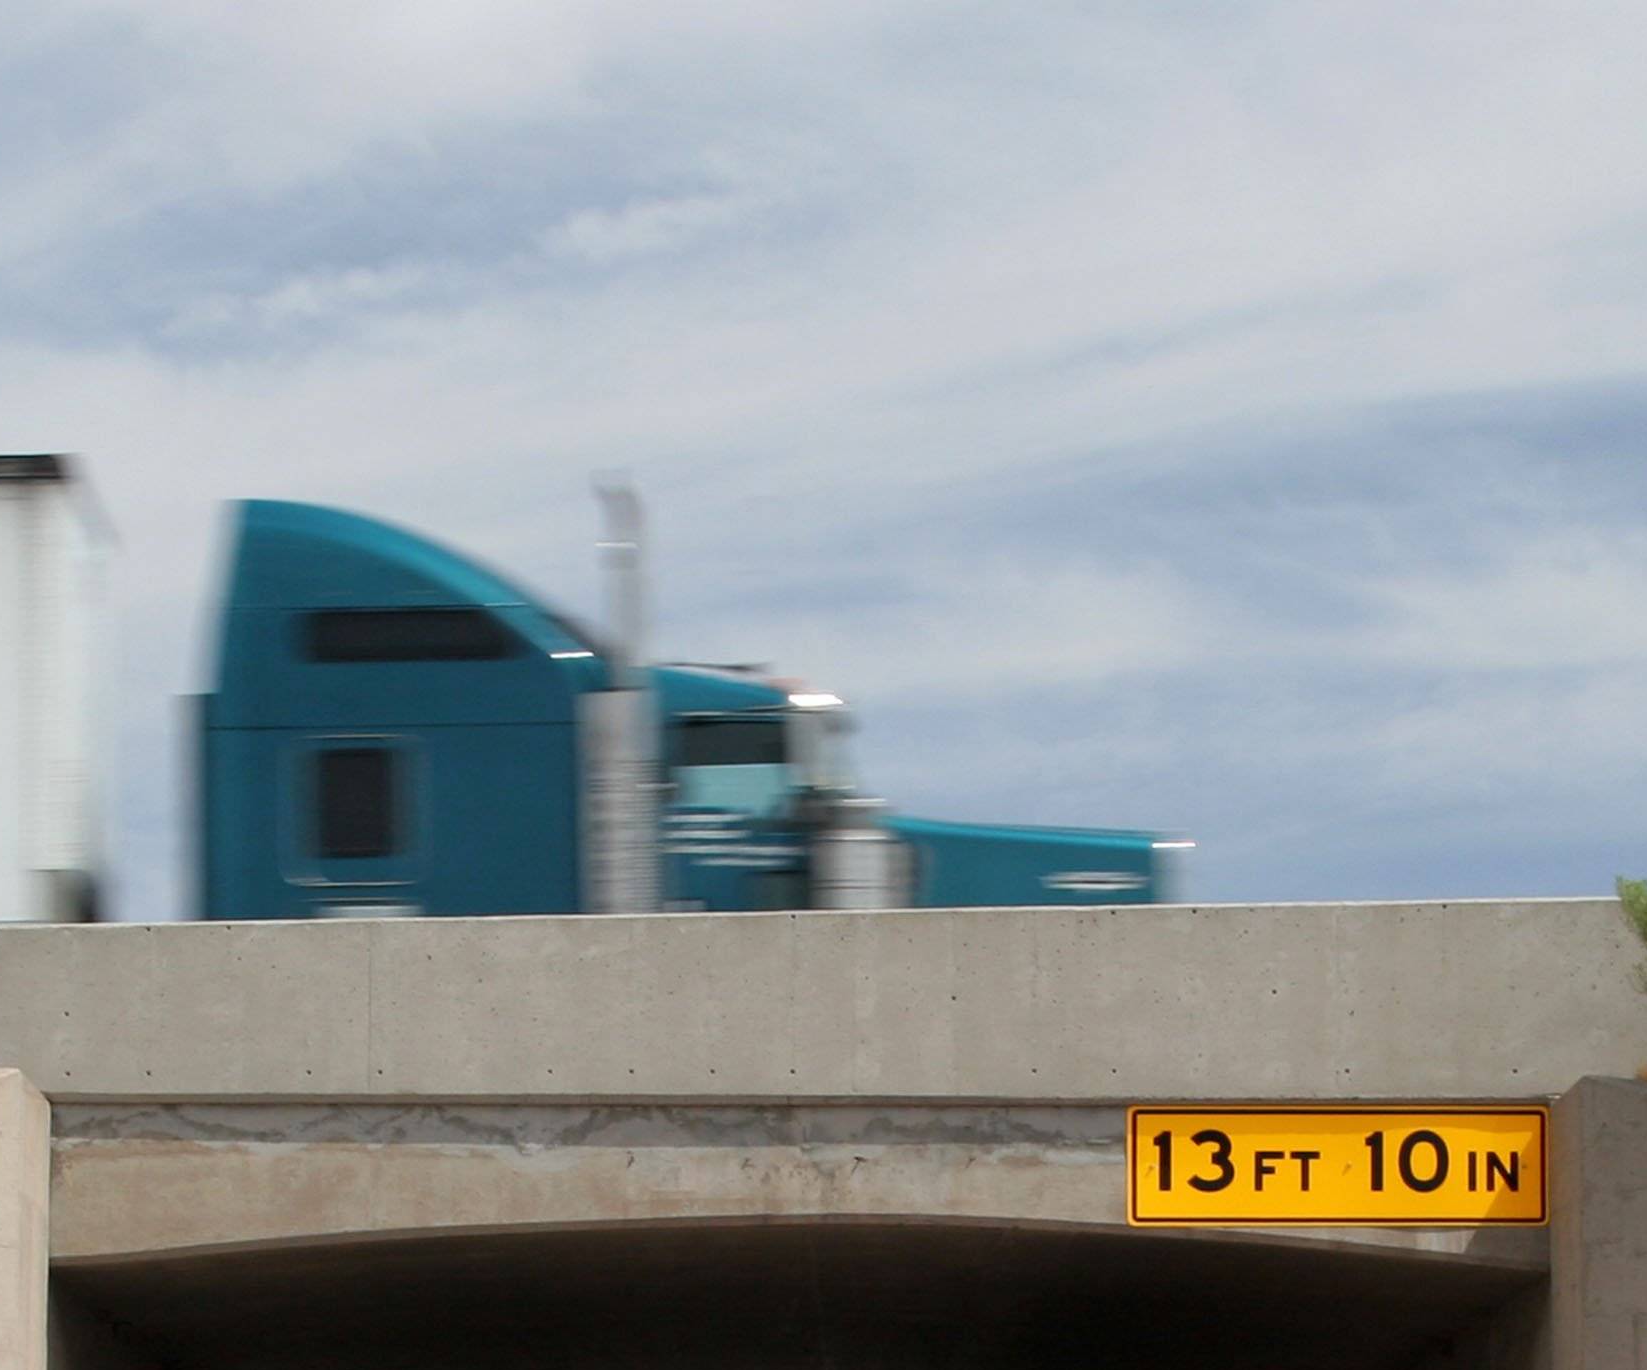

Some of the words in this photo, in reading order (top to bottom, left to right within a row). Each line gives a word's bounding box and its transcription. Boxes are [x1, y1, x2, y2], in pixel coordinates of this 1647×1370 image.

[1153, 1129, 1235, 1192] 13
[1254, 1151, 1321, 1192] FT
[1365, 1129, 1449, 1192] 10
[1467, 1151, 1520, 1192] IN
